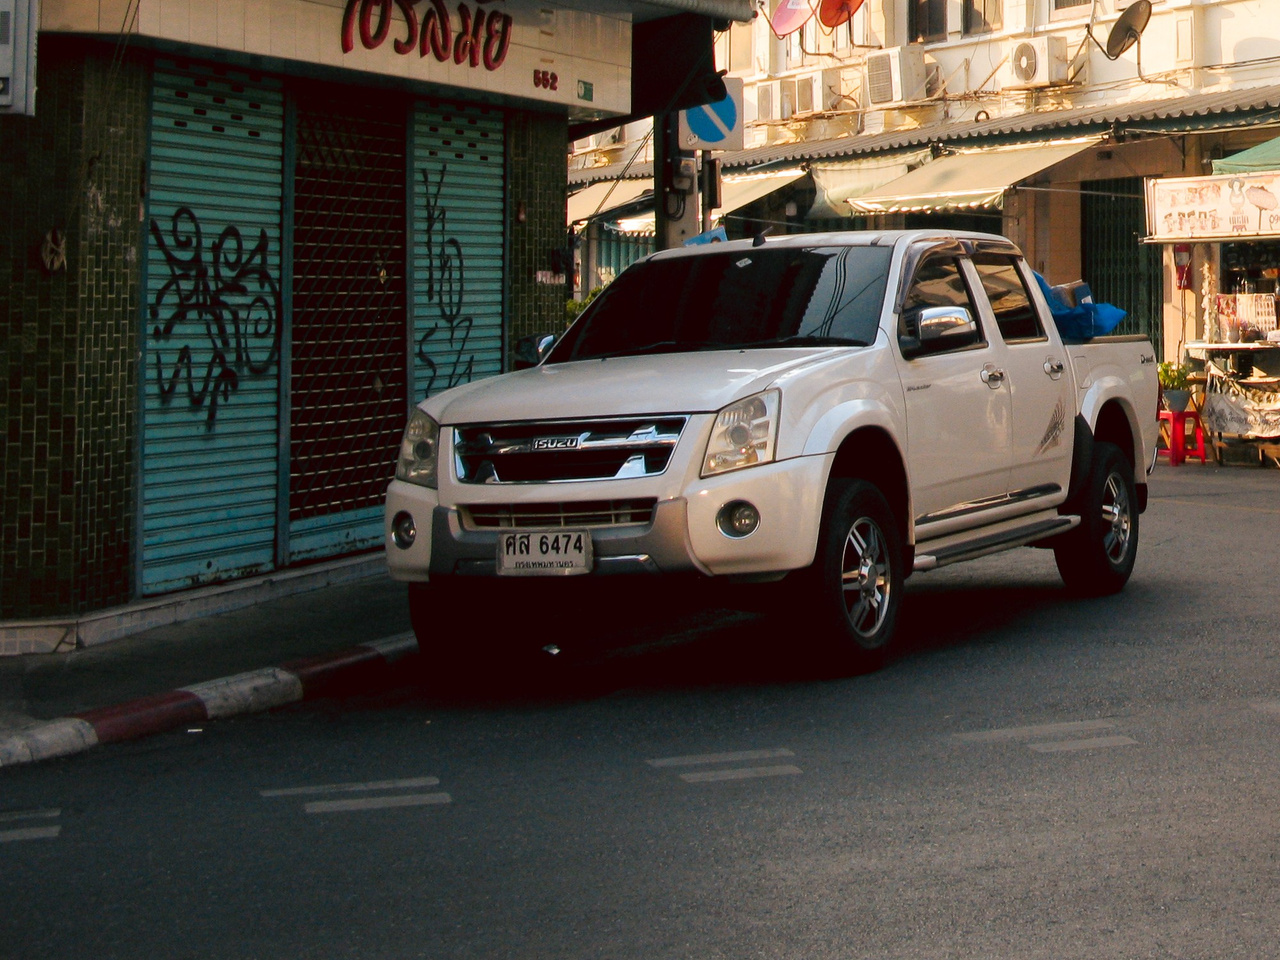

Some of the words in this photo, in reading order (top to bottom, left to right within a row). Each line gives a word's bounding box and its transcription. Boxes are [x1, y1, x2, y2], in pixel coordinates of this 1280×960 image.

[533, 69, 558, 91] 552
[534, 439, 577, 449] ISUZU
[506, 534, 530, 555] ศส
[540, 534, 583, 554] 6474
